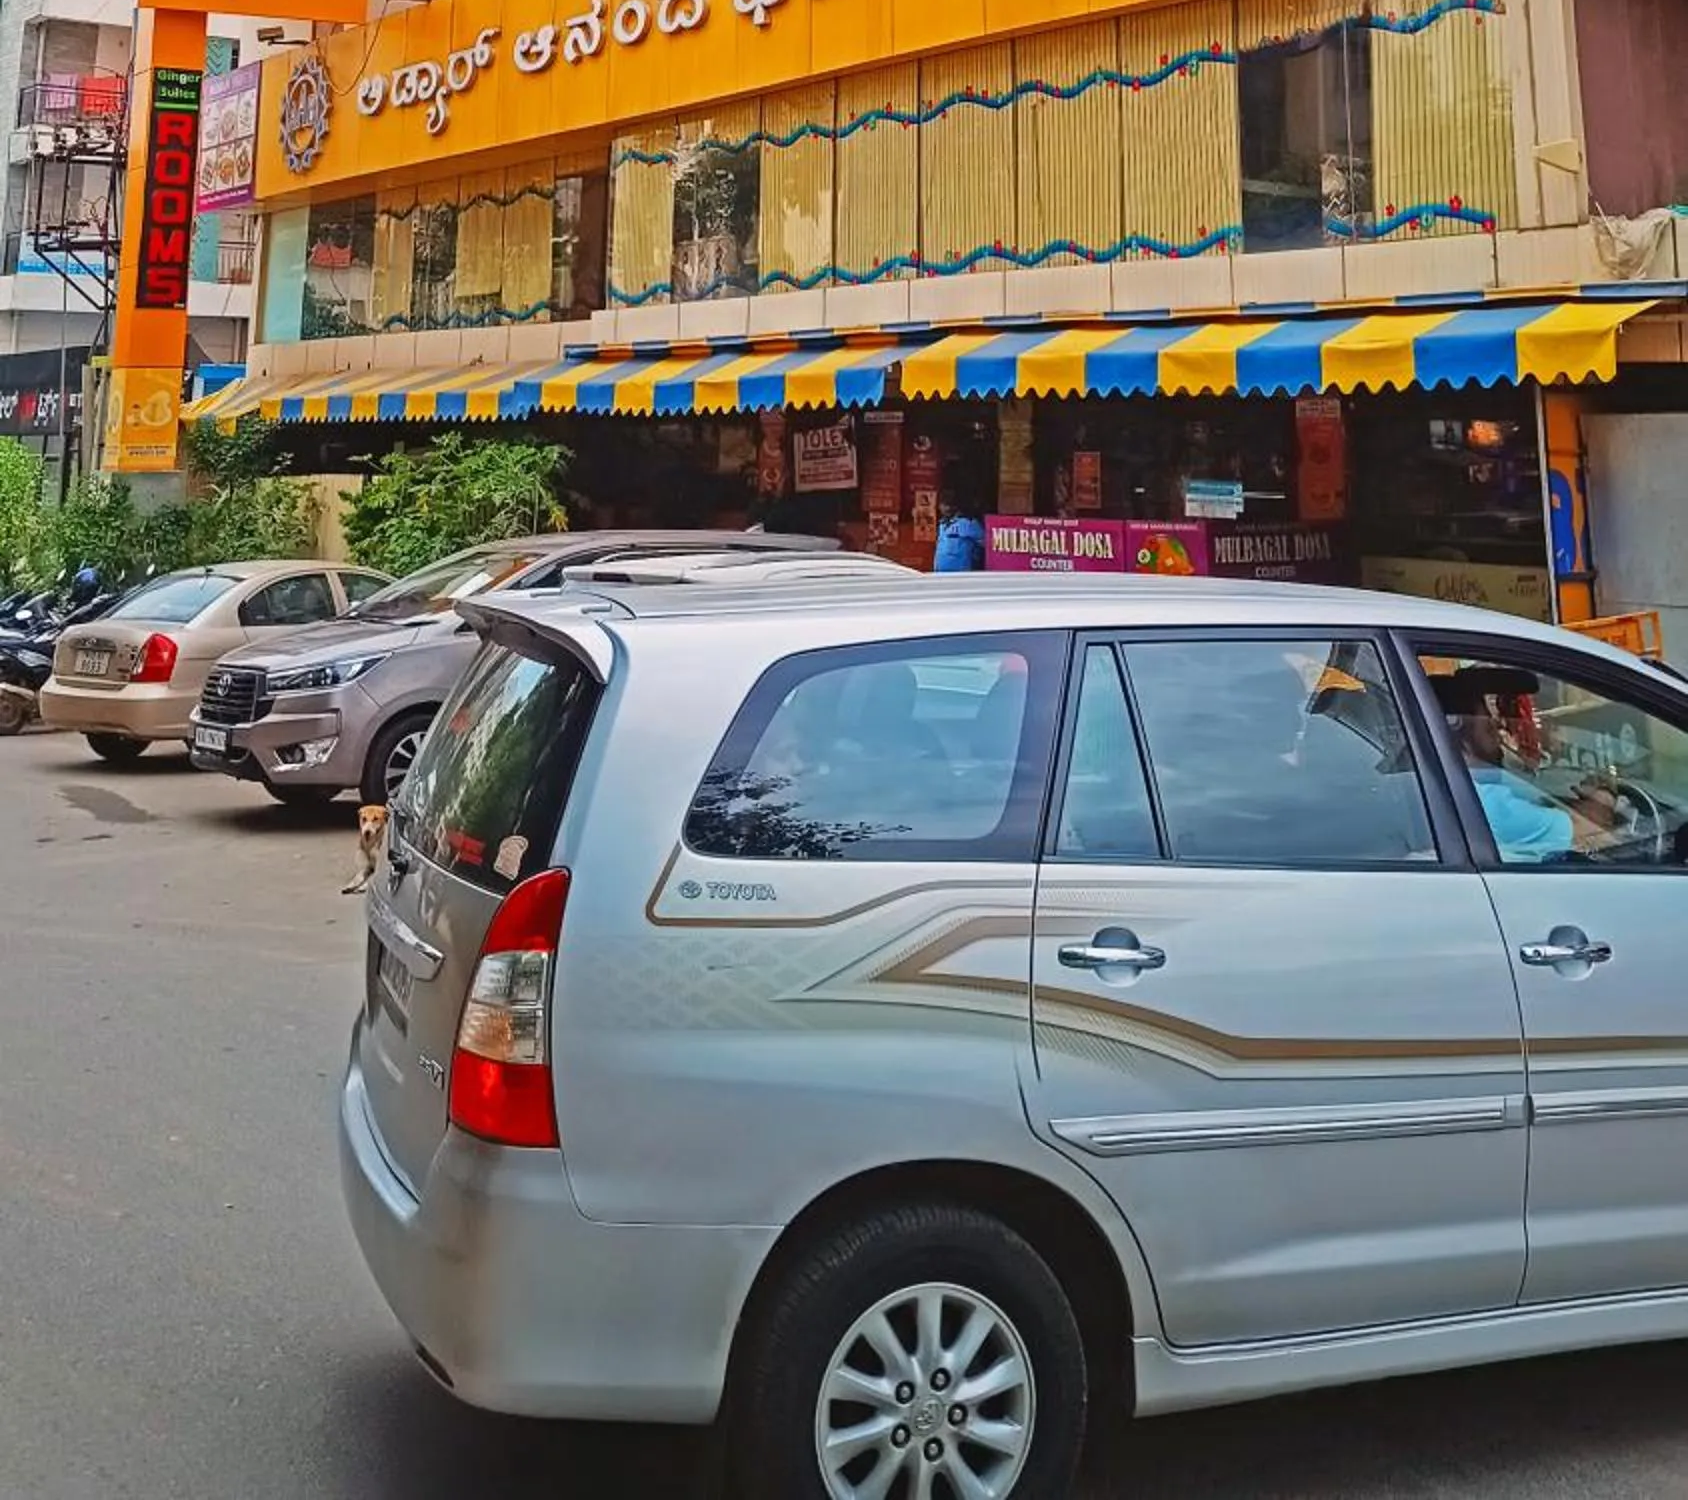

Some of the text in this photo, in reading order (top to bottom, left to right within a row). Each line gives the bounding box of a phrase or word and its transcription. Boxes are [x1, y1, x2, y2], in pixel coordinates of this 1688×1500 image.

[145, 112, 194, 304] ROOMS
[992, 527, 1115, 559] MULBAGAL DOSA
[1214, 533, 1291, 564] MULBAGAL
[1030, 557, 1074, 571] COUNTER
[706, 882, 777, 901] TOYOTA
